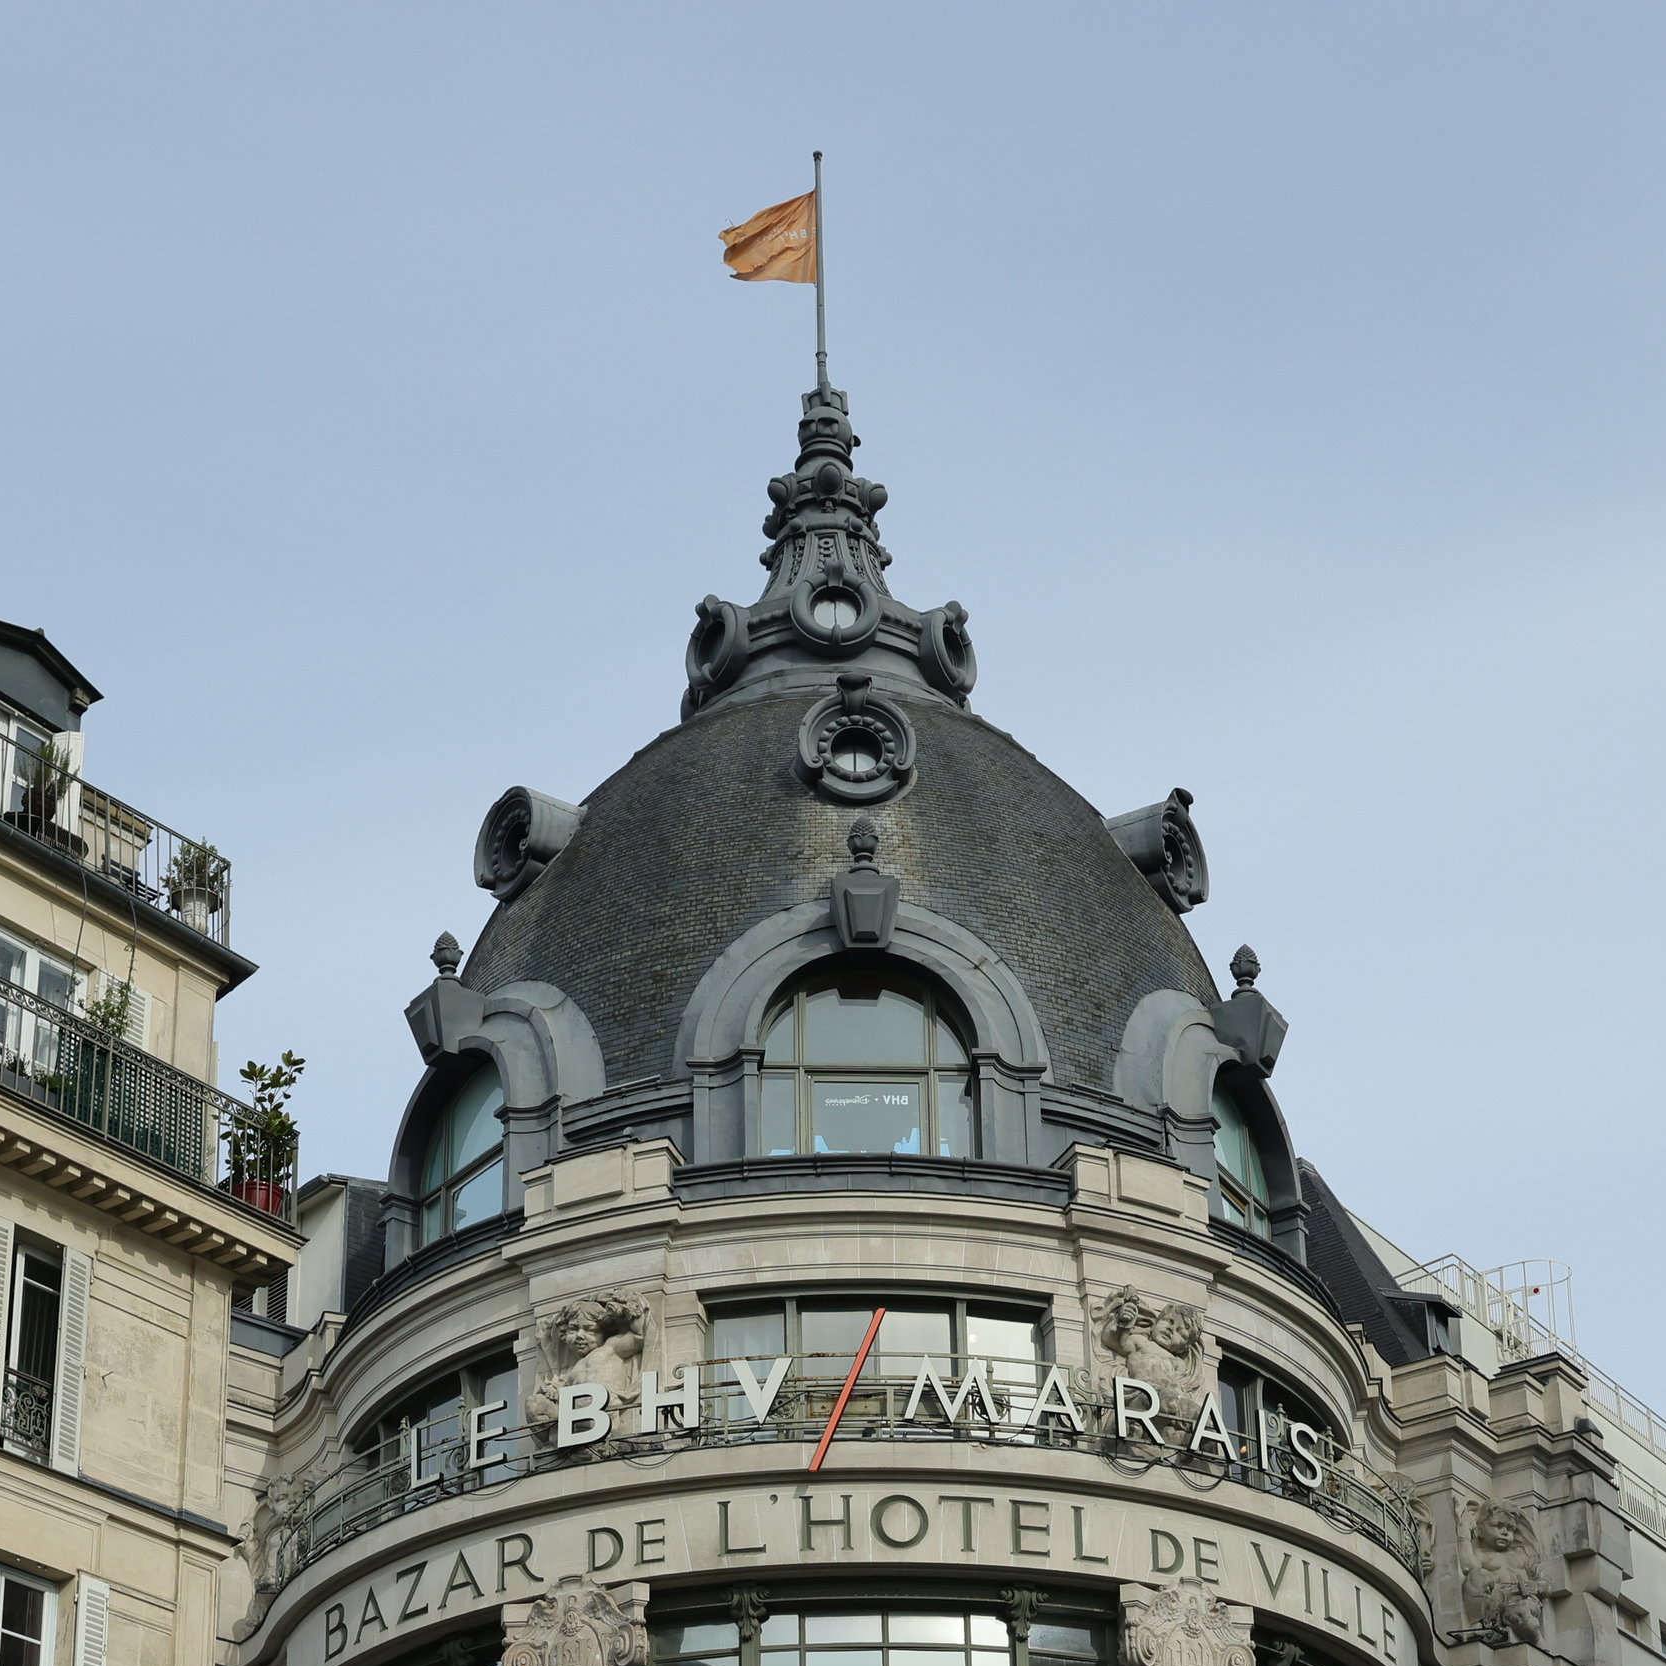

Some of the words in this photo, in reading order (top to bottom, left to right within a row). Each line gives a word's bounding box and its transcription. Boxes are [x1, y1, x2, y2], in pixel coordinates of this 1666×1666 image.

[409, 1399, 508, 1488] LE
[558, 1357, 792, 1451] BHV
[906, 1355, 1326, 1488] MARAIS
[323, 1533, 542, 1665] BAZAR
[586, 1518, 667, 1573] DE
[1150, 1528, 1223, 1586] DE
[1251, 1539, 1398, 1665] VILLE
